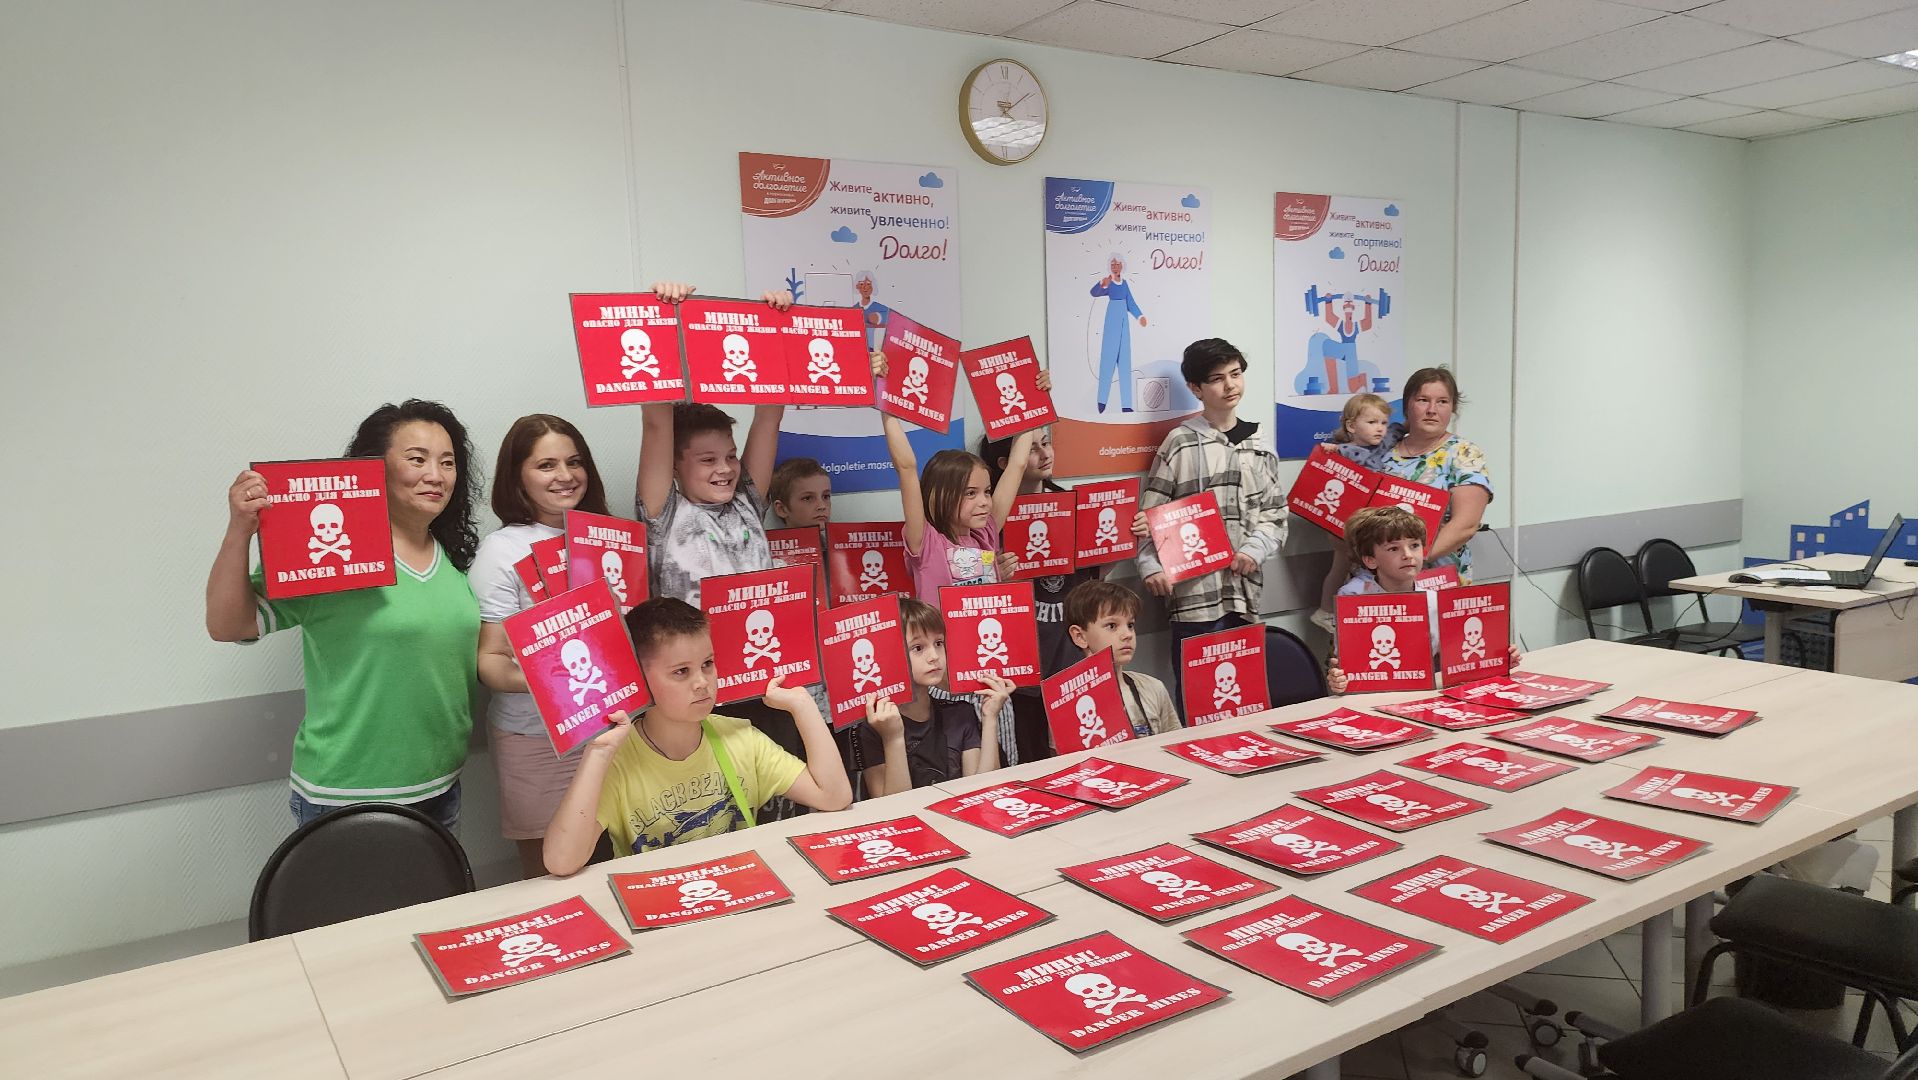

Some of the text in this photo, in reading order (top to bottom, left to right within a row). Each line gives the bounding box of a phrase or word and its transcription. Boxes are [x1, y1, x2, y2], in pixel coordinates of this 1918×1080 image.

[829, 181, 934, 208] Живите активно,
[830, 206, 950, 230] живите увлеченно!
[1113, 202, 1193, 224] Живите активно,
[1330, 212, 1392, 231] Живите активно,
[1115, 223, 1204, 245] живите интересно!
[1354, 238, 1402, 250] спортивно!
[880, 236, 948, 261] Долго!
[1150, 248, 1203, 270] Долго!
[1358, 254, 1400, 272] Долго!
[599, 305, 661, 319] МИНЫ!
[703, 311, 759, 326] МИНЫ!
[791, 316, 843, 330] МИНЫ!
[688, 323, 722, 331] ОПАСНО
[746, 325, 777, 334] ЖИЗНИ
[902, 330, 943, 357] МИНЫ!
[978, 350, 1018, 370] МИНЫ!
[596, 381, 648, 393] DANGER
[700, 383, 785, 393] DANGER MINES
[834, 385, 867, 395] MINES
[881, 390, 944, 422] DANGER MINES
[989, 406, 1048, 429] DANGER MINES
[1324, 458, 1363, 483] МИНЫ!
[287, 474, 358, 494] МИНЫ!
[267, 489, 380, 503] ОПАСНО ДЛЯ ЖИЗНИ
[1088, 489, 1125, 503] МИНЫ!
[1018, 501, 1057, 515] МИНЫ!
[587, 525, 630, 543] МИНЫ!
[847, 531, 893, 542] МИНЫ!
[1078, 542, 1133, 558] DANGER MINES
[1204, 550, 1228, 564] MINES
[278, 560, 386, 582] DANGER MINES
[1043, 557, 1068, 567] MINES
[709, 591, 807, 614] ОПАСНО ДЛЯ ЖИЗНИ
[728, 580, 788, 603] МИНЫ!
[961, 594, 1012, 610] МИНЫ!
[1453, 594, 1491, 611] МИНЫ!
[531, 602, 591, 641] МИНЫ!
[947, 606, 1028, 618] ОПАСНО ДЛЯ ЖИЗНИ
[1357, 604, 1407, 617] МИНЫ!
[521, 609, 612, 657] ОПАСНО ДЛЯ ЖИЗНИ
[834, 610, 880, 635] МИНЫ!
[1201, 638, 1247, 658] МИНЫ!
[717, 660, 811, 688] DANGER MINES
[1001, 664, 1034, 676] MINES
[1348, 670, 1425, 681] DANGER MINES
[1446, 657, 1503, 674] DANGER MINES
[1059, 666, 1099, 697] МИНЫ!
[555, 682, 638, 735] DANGER MINES
[630, 781, 688, 835] BLACK
[825, 826, 898, 844] МИНЫ!
[838, 849, 951, 875] DANGER MINES
[1096, 856, 1167, 876] МИНЫ!
[649, 864, 729, 884] МИНЫ!
[1390, 868, 1453, 892] МИНЫ!
[645, 890, 776, 921] DANGER MINES
[868, 885, 943, 913] МИНЫ!
[1152, 882, 1255, 911] DANGER MINES
[1479, 892, 1566, 932] DANGER MINES
[462, 914, 554, 942] МИНЫ!
[916, 910, 1029, 953] DANGER MINES
[1223, 913, 1296, 941] МИНЫ!
[464, 942, 611, 985] DANGER MINES
[1001, 951, 1133, 994] ОПАСНО ДЛЯ ЖИЗНИ
[1012, 950, 1101, 982] МИНЫ!
[1307, 942, 1408, 988] DANGER MINES
[1070, 988, 1200, 1038] DANGER MINES
